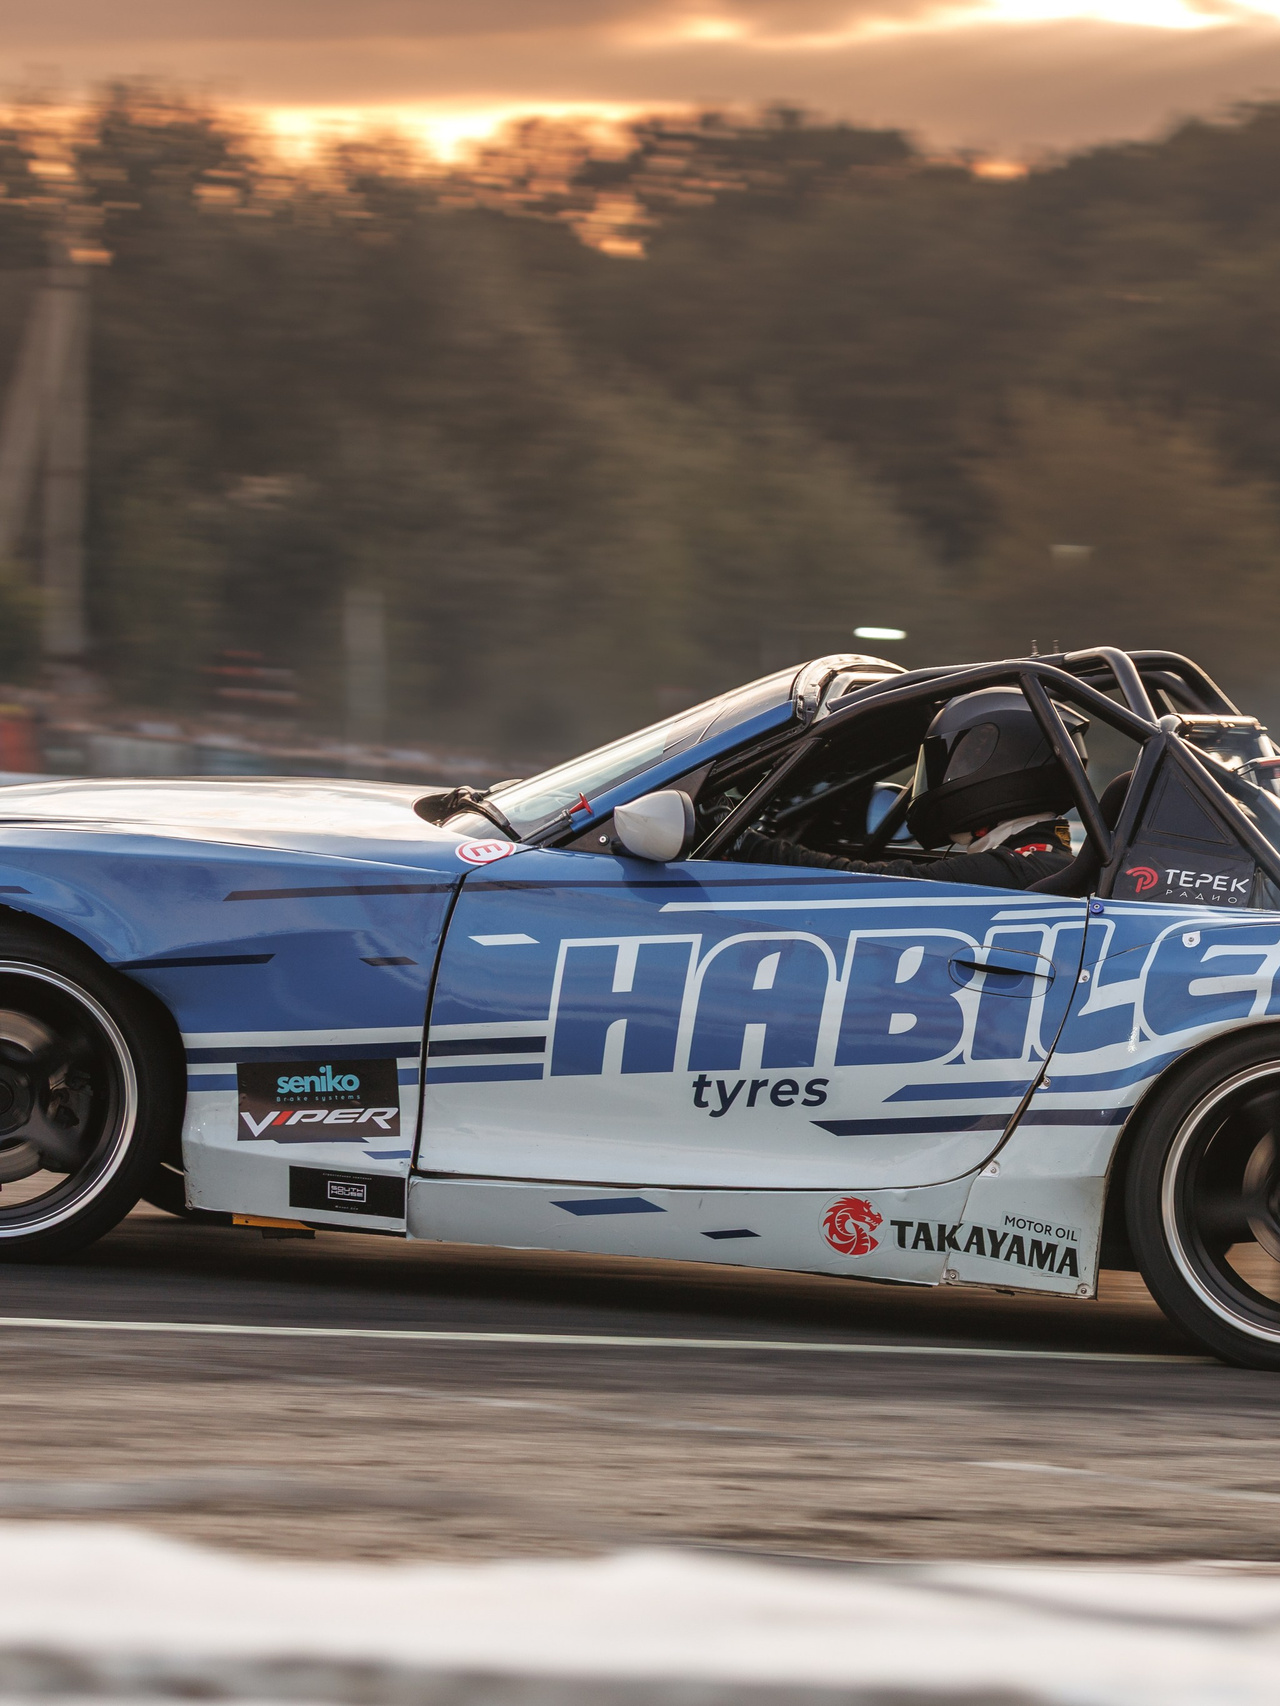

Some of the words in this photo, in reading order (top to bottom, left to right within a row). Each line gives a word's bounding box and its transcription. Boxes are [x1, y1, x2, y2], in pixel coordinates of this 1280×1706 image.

[1165, 868, 1250, 894] ТЕРЕК
[1165, 889, 1238, 904] РАДИО
[276, 1065, 360, 1094] seniko
[314, 1094, 361, 1102] systems
[692, 1074, 830, 1118] tyres
[239, 1107, 399, 1138] VIPER
[1004, 1214, 1052, 1236] MOTOR
[1055, 1227, 1078, 1242] OIL
[890, 1219, 1080, 1278] TAKAYAMA
